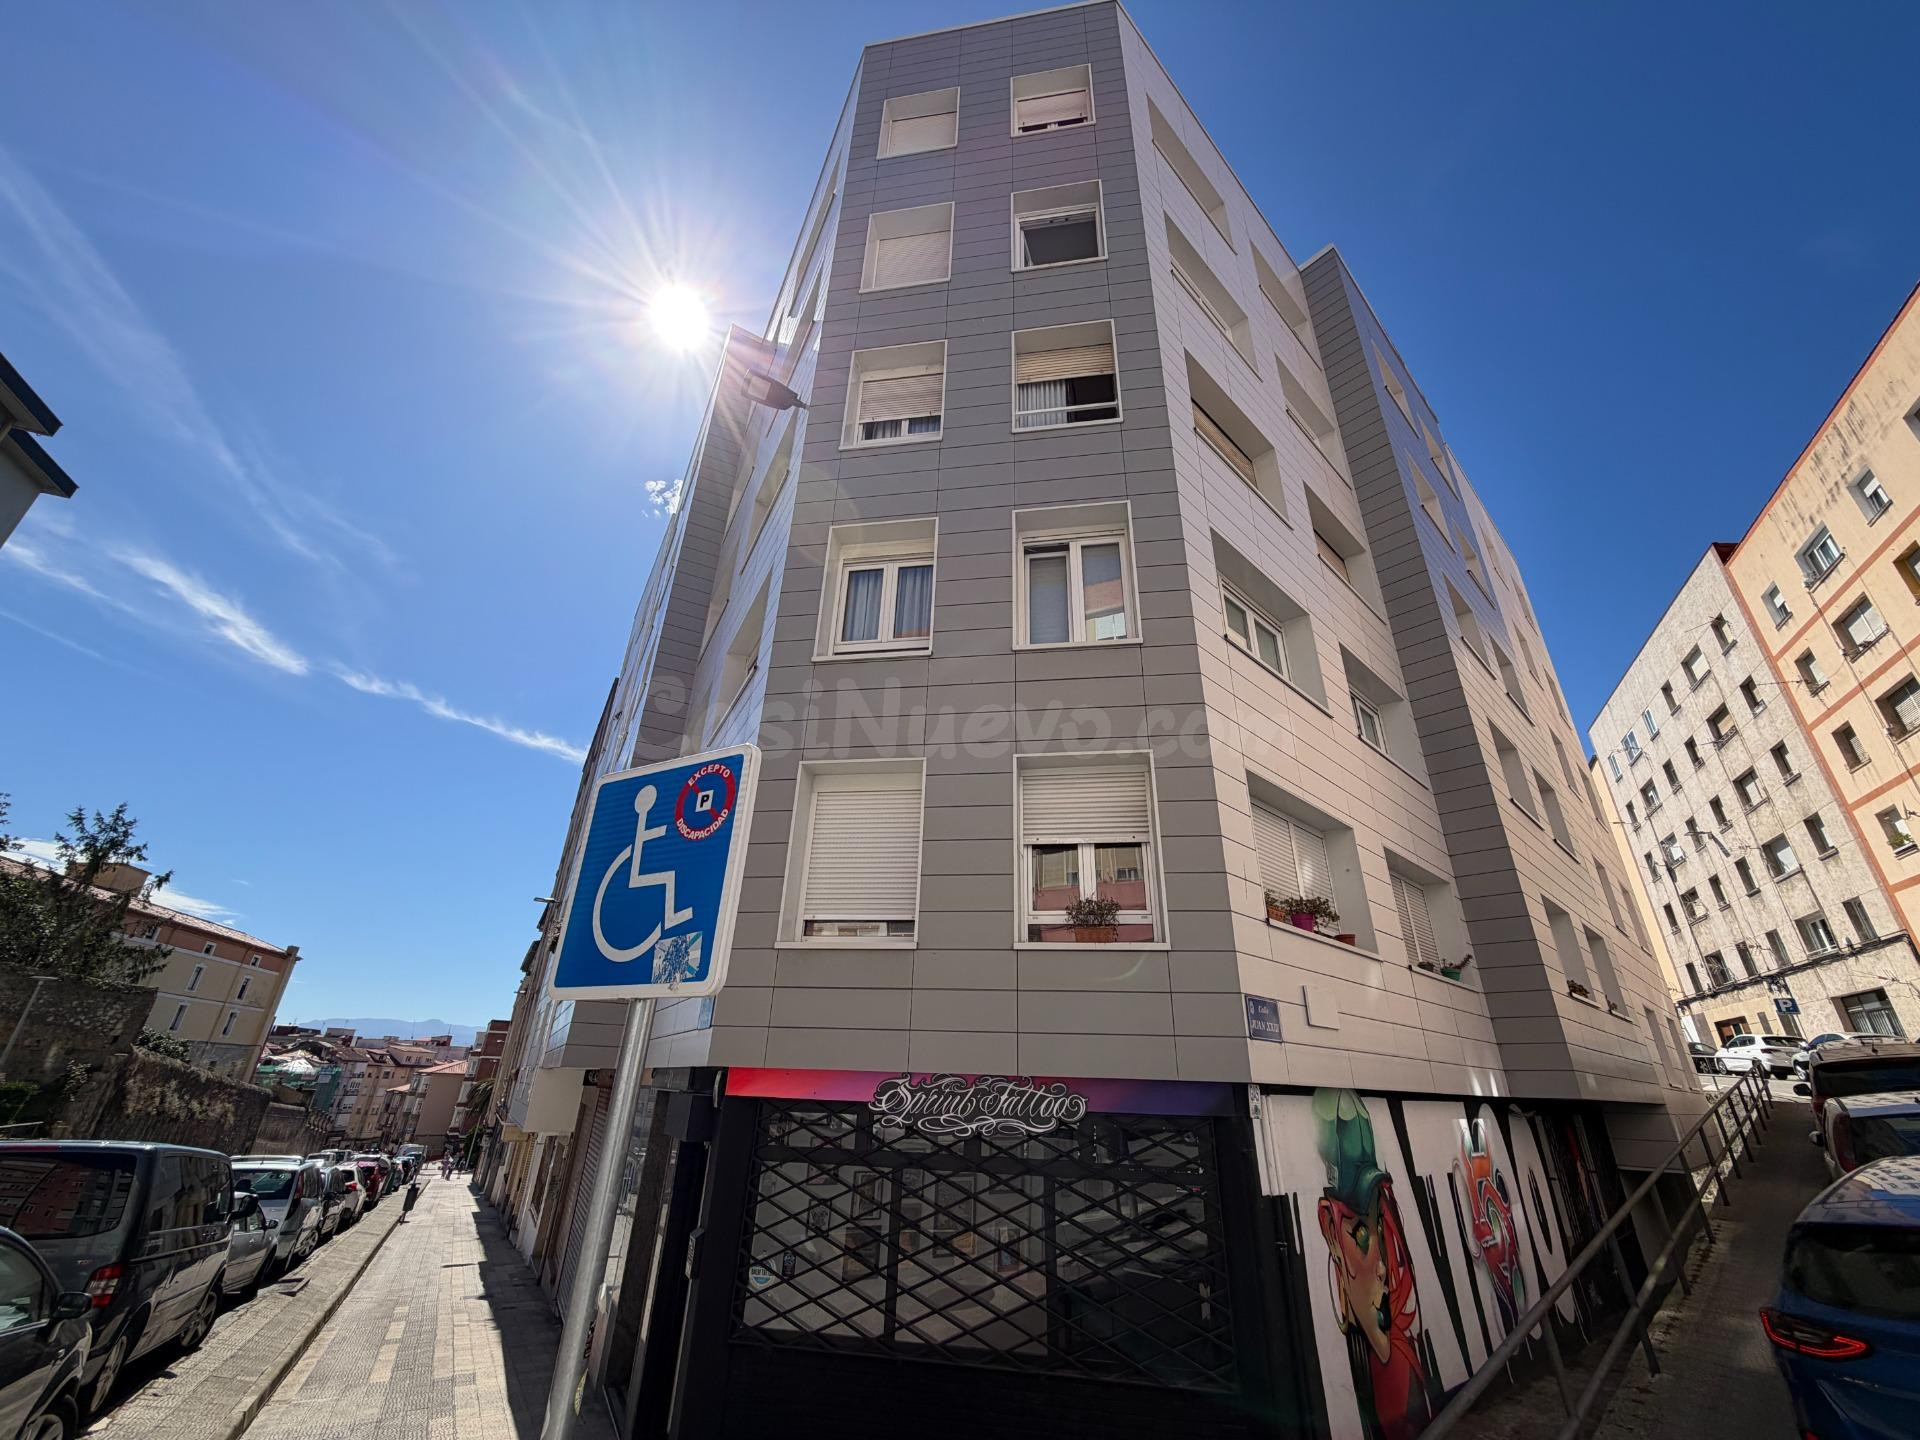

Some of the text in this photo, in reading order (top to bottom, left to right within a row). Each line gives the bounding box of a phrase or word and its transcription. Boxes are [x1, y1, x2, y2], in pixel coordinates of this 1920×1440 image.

[687, 763, 730, 787] EXCEPTO
[699, 793, 710, 808] P
[676, 808, 729, 841] DISCAPACIDAD
[1779, 999, 1793, 1012] P
[979, 1077, 1088, 1126] Tattoo
